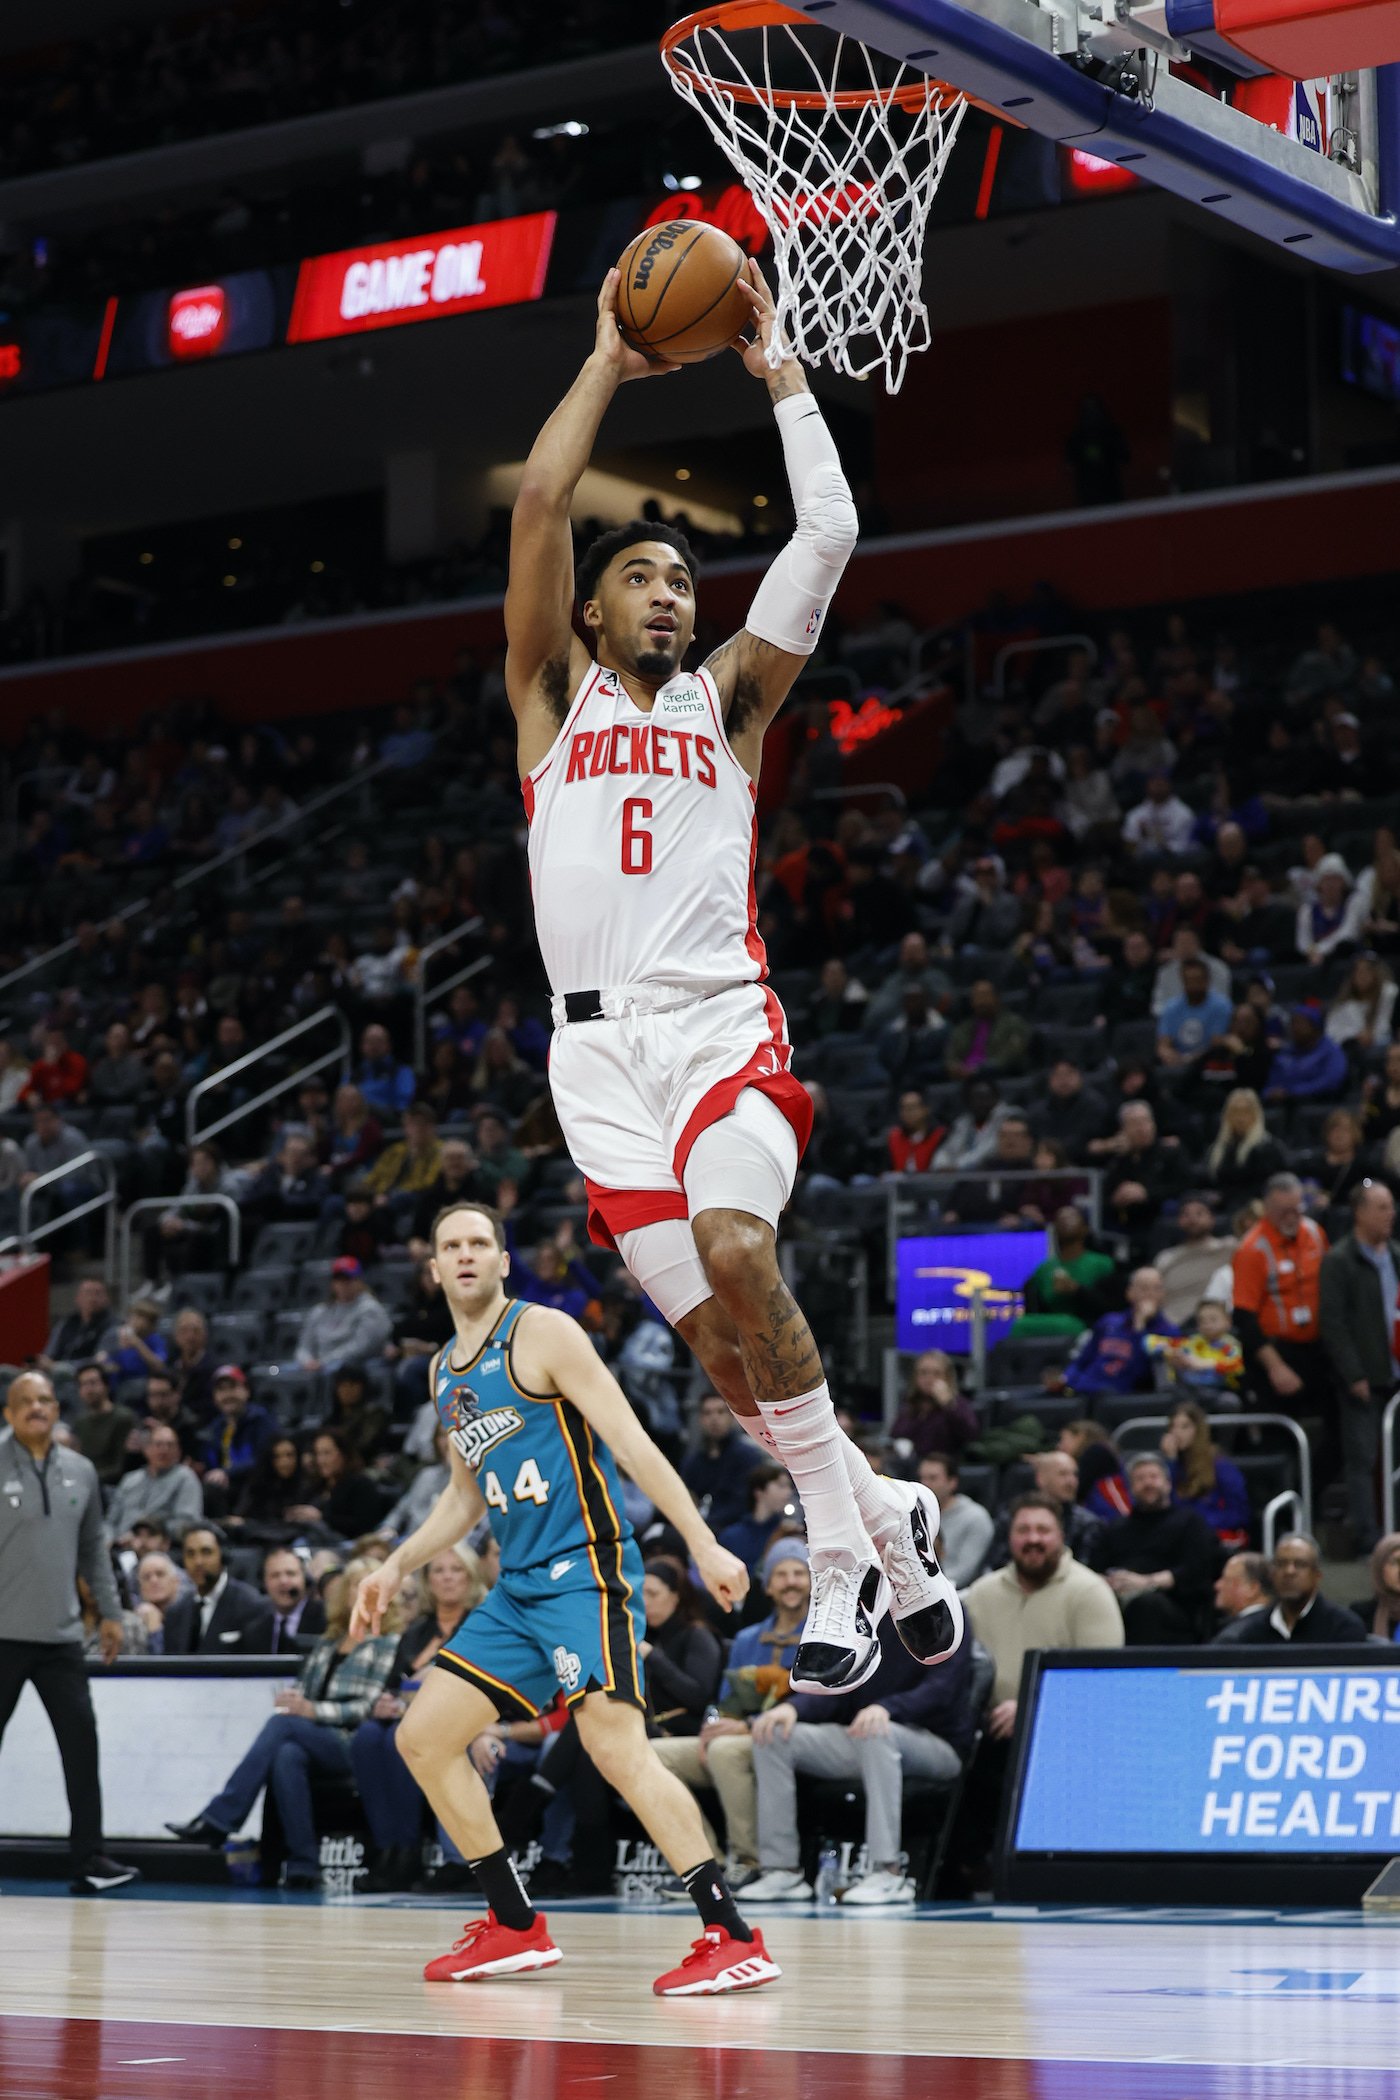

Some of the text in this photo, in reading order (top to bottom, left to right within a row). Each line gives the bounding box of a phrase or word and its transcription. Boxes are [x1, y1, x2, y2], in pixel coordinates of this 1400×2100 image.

[1299, 113, 1317, 146] NBA
[340, 240, 486, 320] GAME ON.
[633, 221, 697, 290] Wilson
[662, 690, 701, 704] credit
[663, 700, 705, 713] karma
[565, 724, 717, 790] ROCKETS
[621, 797, 653, 875] 6
[448, 1409, 522, 1468] PISTONS
[485, 1458, 549, 1514] 44
[1209, 1734, 1367, 1780] FORD
[1201, 1790, 1400, 1837] HEALT
[319, 1836, 365, 1867] ittle
